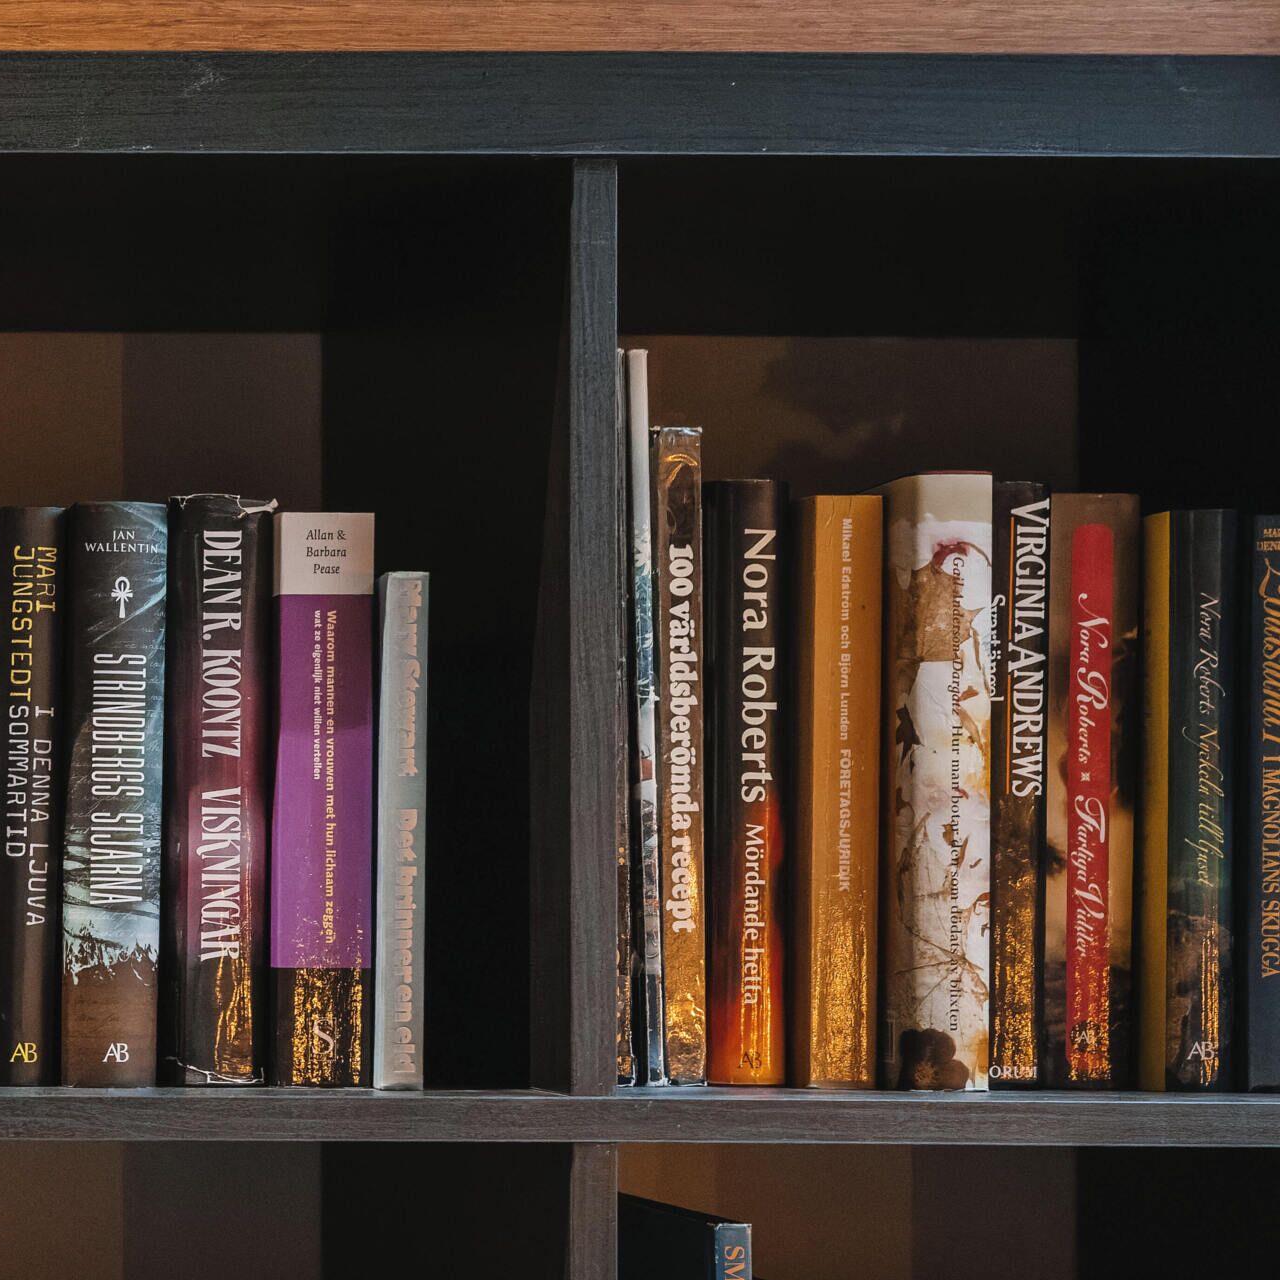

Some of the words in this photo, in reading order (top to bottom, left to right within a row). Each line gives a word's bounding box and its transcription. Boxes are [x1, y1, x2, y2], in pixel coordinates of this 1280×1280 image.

[669, 543, 694, 596] 100
[742, 527, 777, 631] Nora
[1008, 498, 1050, 642] VIRGINIA
[669, 600, 697, 832] världsberömda
[742, 646, 776, 804] Roberts
[1008, 642, 1045, 797] ANDREWS
[665, 835, 697, 933] recept
[744, 823, 765, 941] Mördande
[742, 946, 763, 1006] hetta
